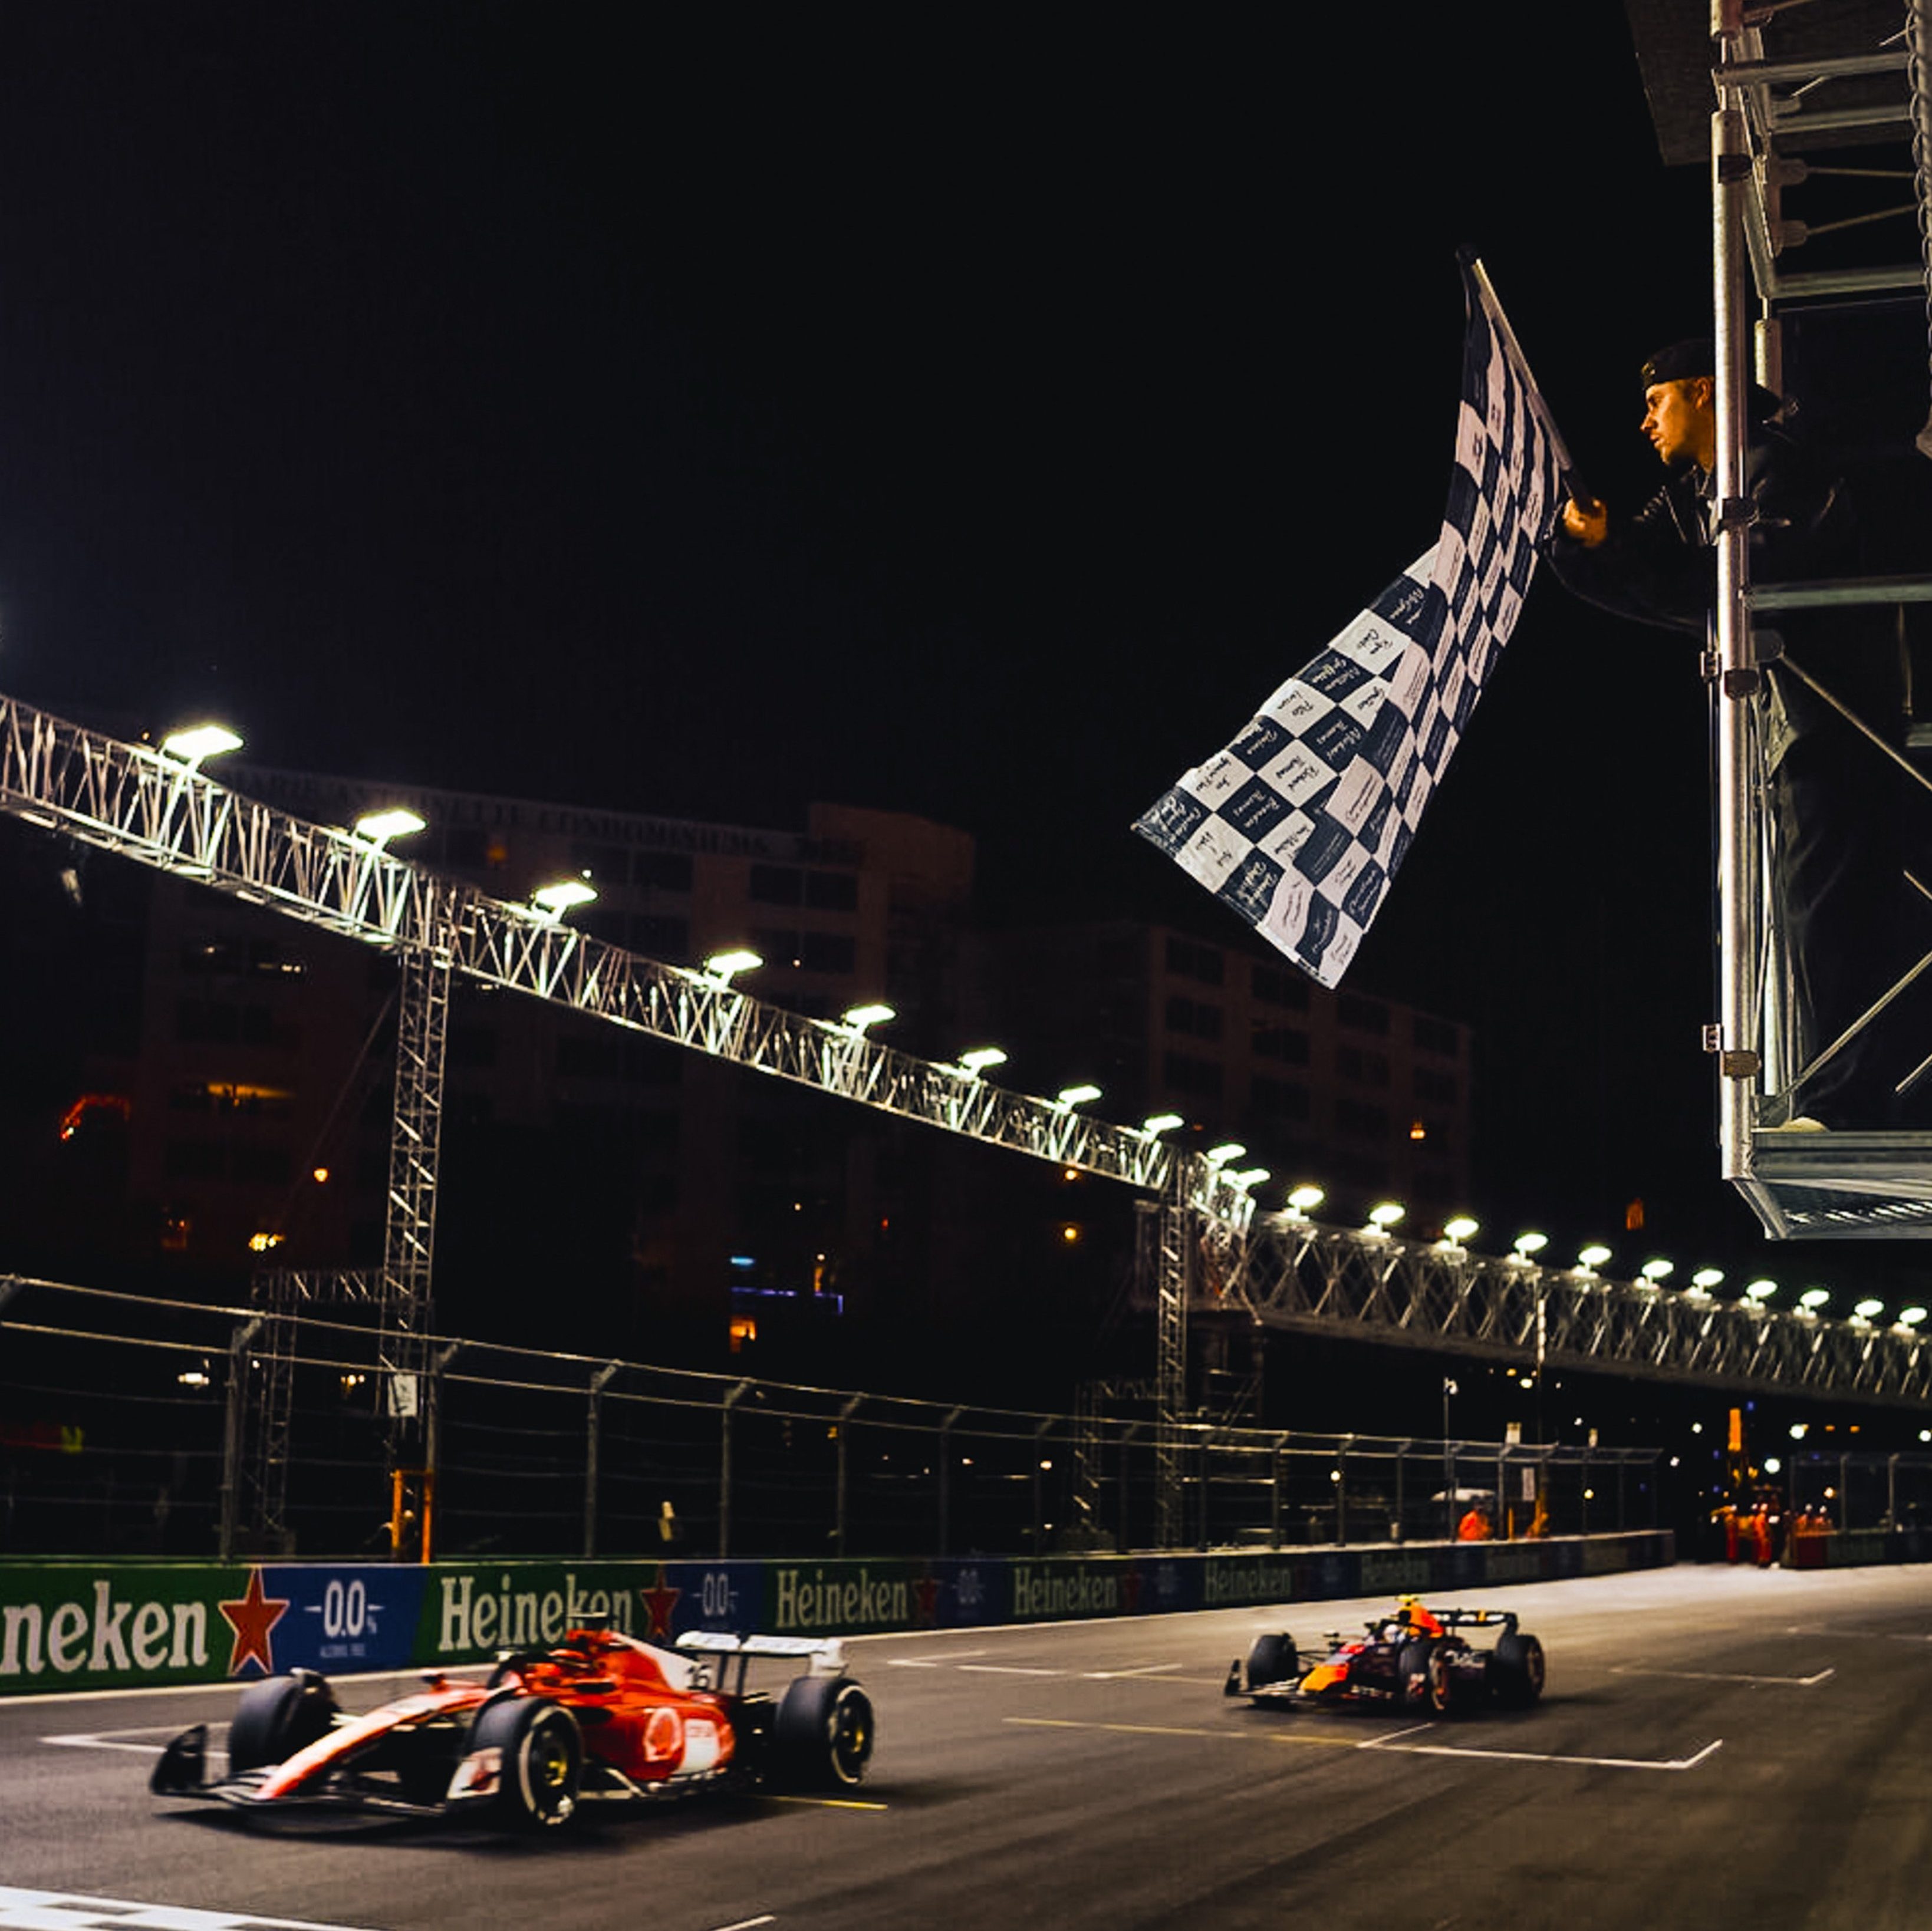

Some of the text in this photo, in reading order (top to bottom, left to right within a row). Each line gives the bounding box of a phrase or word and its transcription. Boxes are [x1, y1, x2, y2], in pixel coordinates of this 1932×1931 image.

[776, 1568, 908, 1627] Heineken
[1015, 1566, 1117, 1616] Heineken
[1204, 1557, 1291, 1602] Heineken
[1, 1580, 208, 1675] neken
